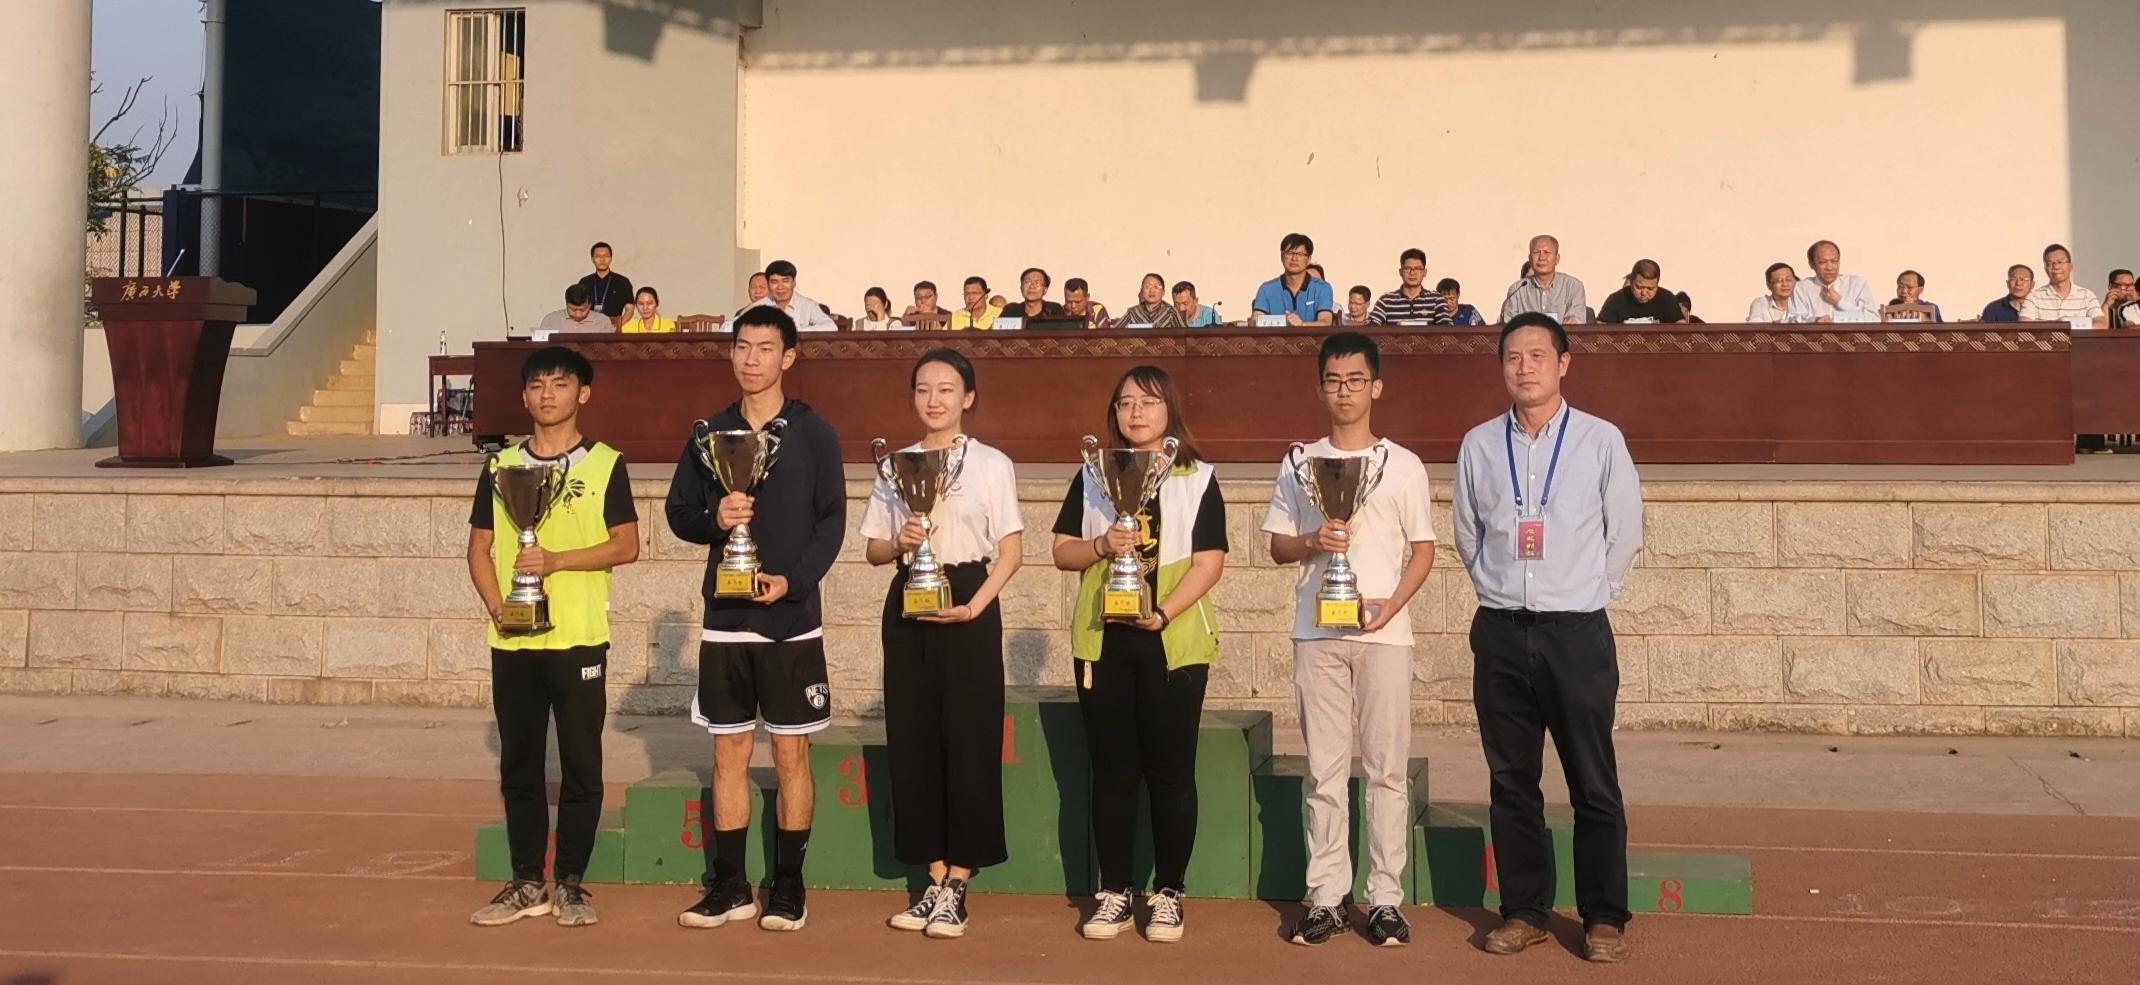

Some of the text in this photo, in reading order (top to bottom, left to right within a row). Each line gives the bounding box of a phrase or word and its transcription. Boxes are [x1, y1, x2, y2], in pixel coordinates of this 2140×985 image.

[806, 684, 829, 697] NETS
[837, 755, 869, 807] 3
[680, 799, 714, 849] 5
[1656, 879, 1684, 914] 8
